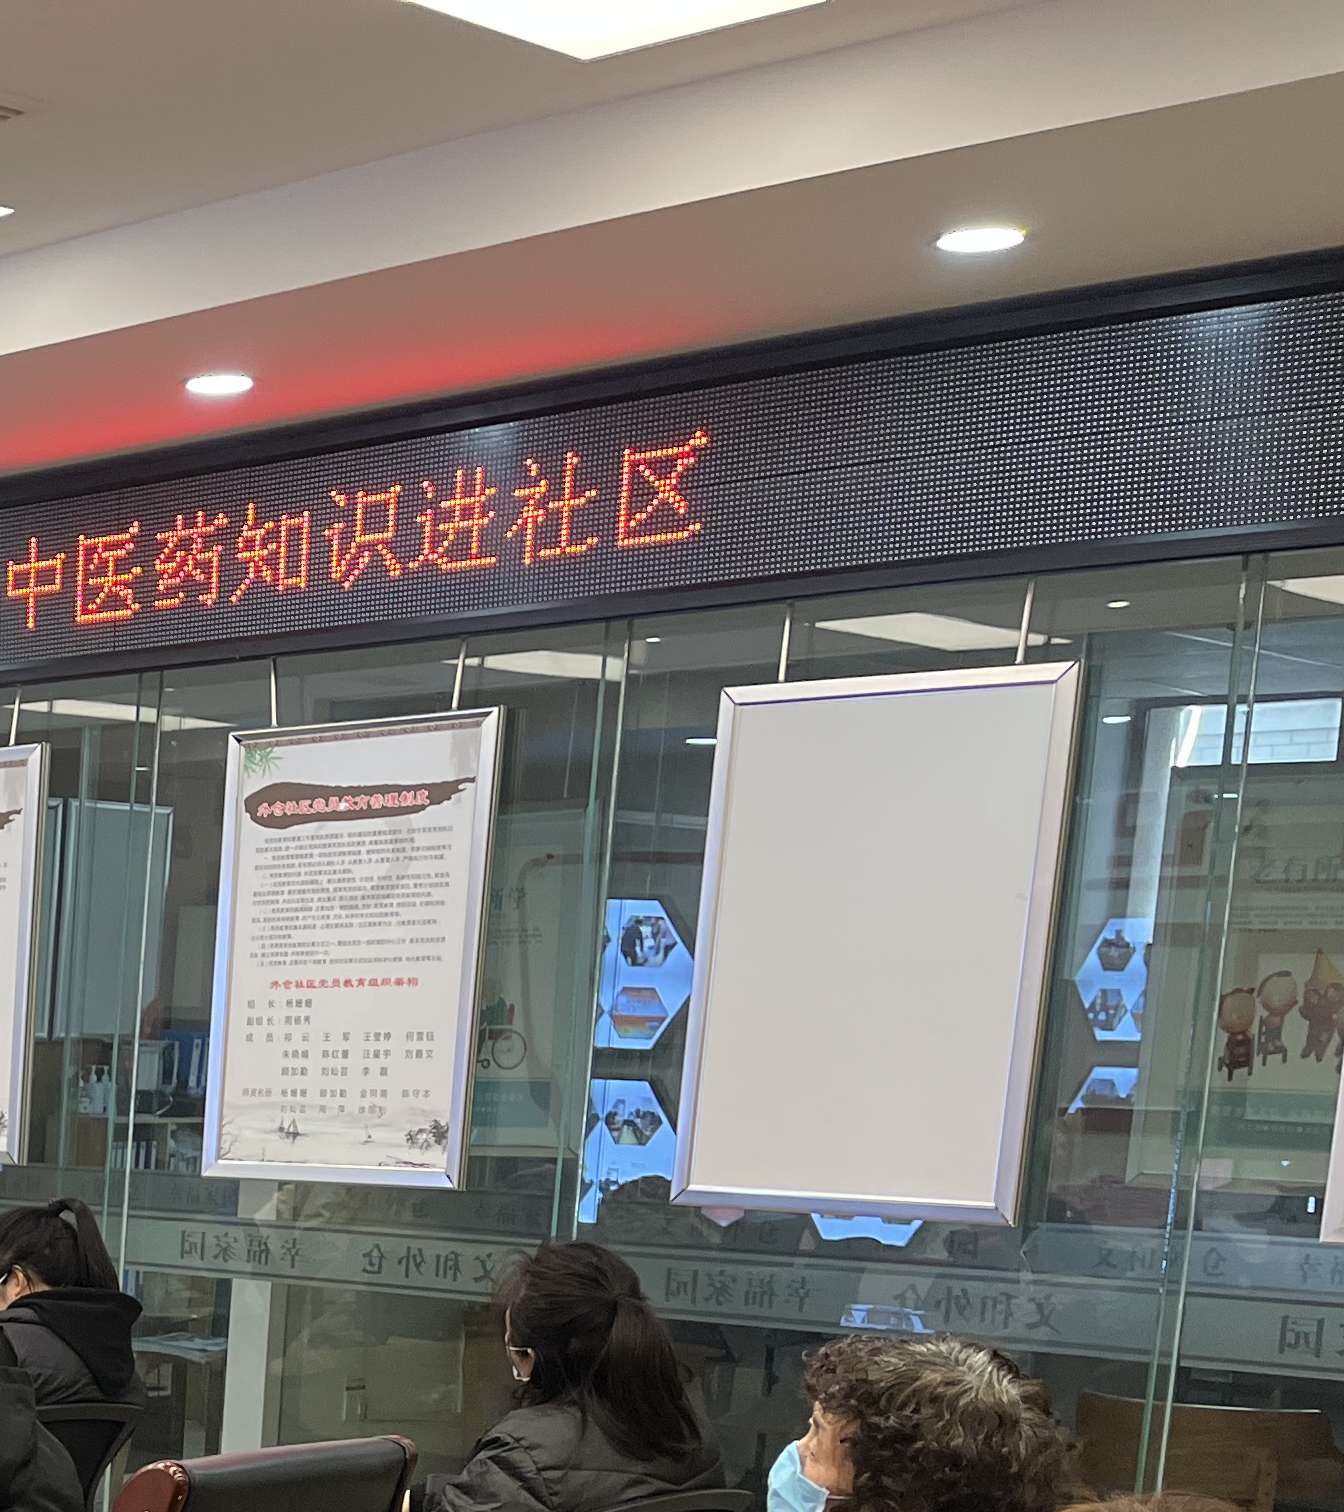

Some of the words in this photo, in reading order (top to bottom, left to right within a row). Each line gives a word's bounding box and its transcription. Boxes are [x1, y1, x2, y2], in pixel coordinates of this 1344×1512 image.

[6, 430, 710, 629] 中医药知识进社区
